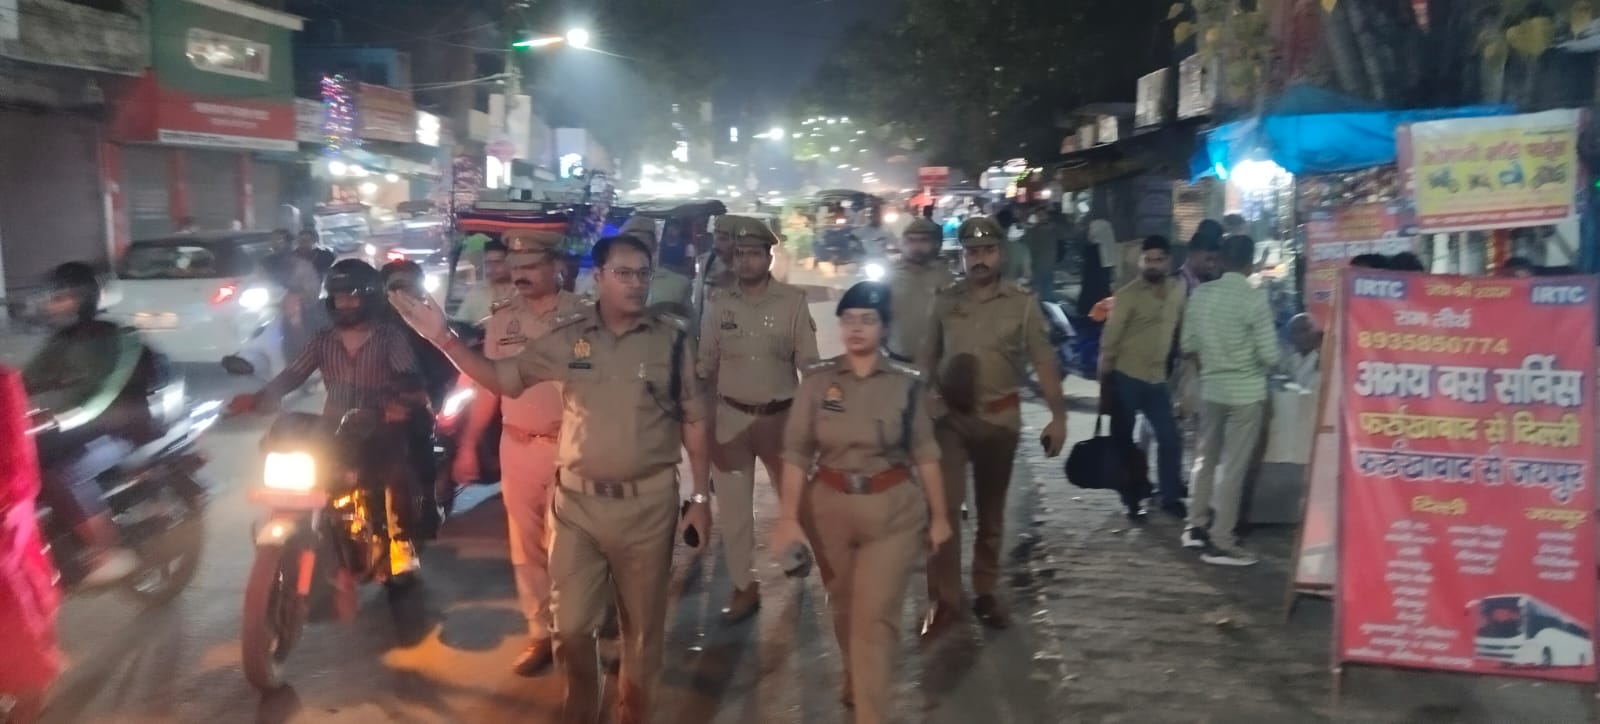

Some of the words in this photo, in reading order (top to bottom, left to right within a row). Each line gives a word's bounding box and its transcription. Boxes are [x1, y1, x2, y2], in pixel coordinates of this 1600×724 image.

[1354, 278, 1404, 298] IRTC
[1531, 286, 1586, 304] IRTC
[1354, 360, 1431, 398] अभय
[1437, 366, 1488, 402] बस
[1494, 354, 1583, 407] सर्विस
[1484, 412, 1508, 443] से
[1513, 411, 1581, 446] दिल्ली
[1480, 446, 1505, 485] से
[1506, 457, 1586, 504] जयपुर
